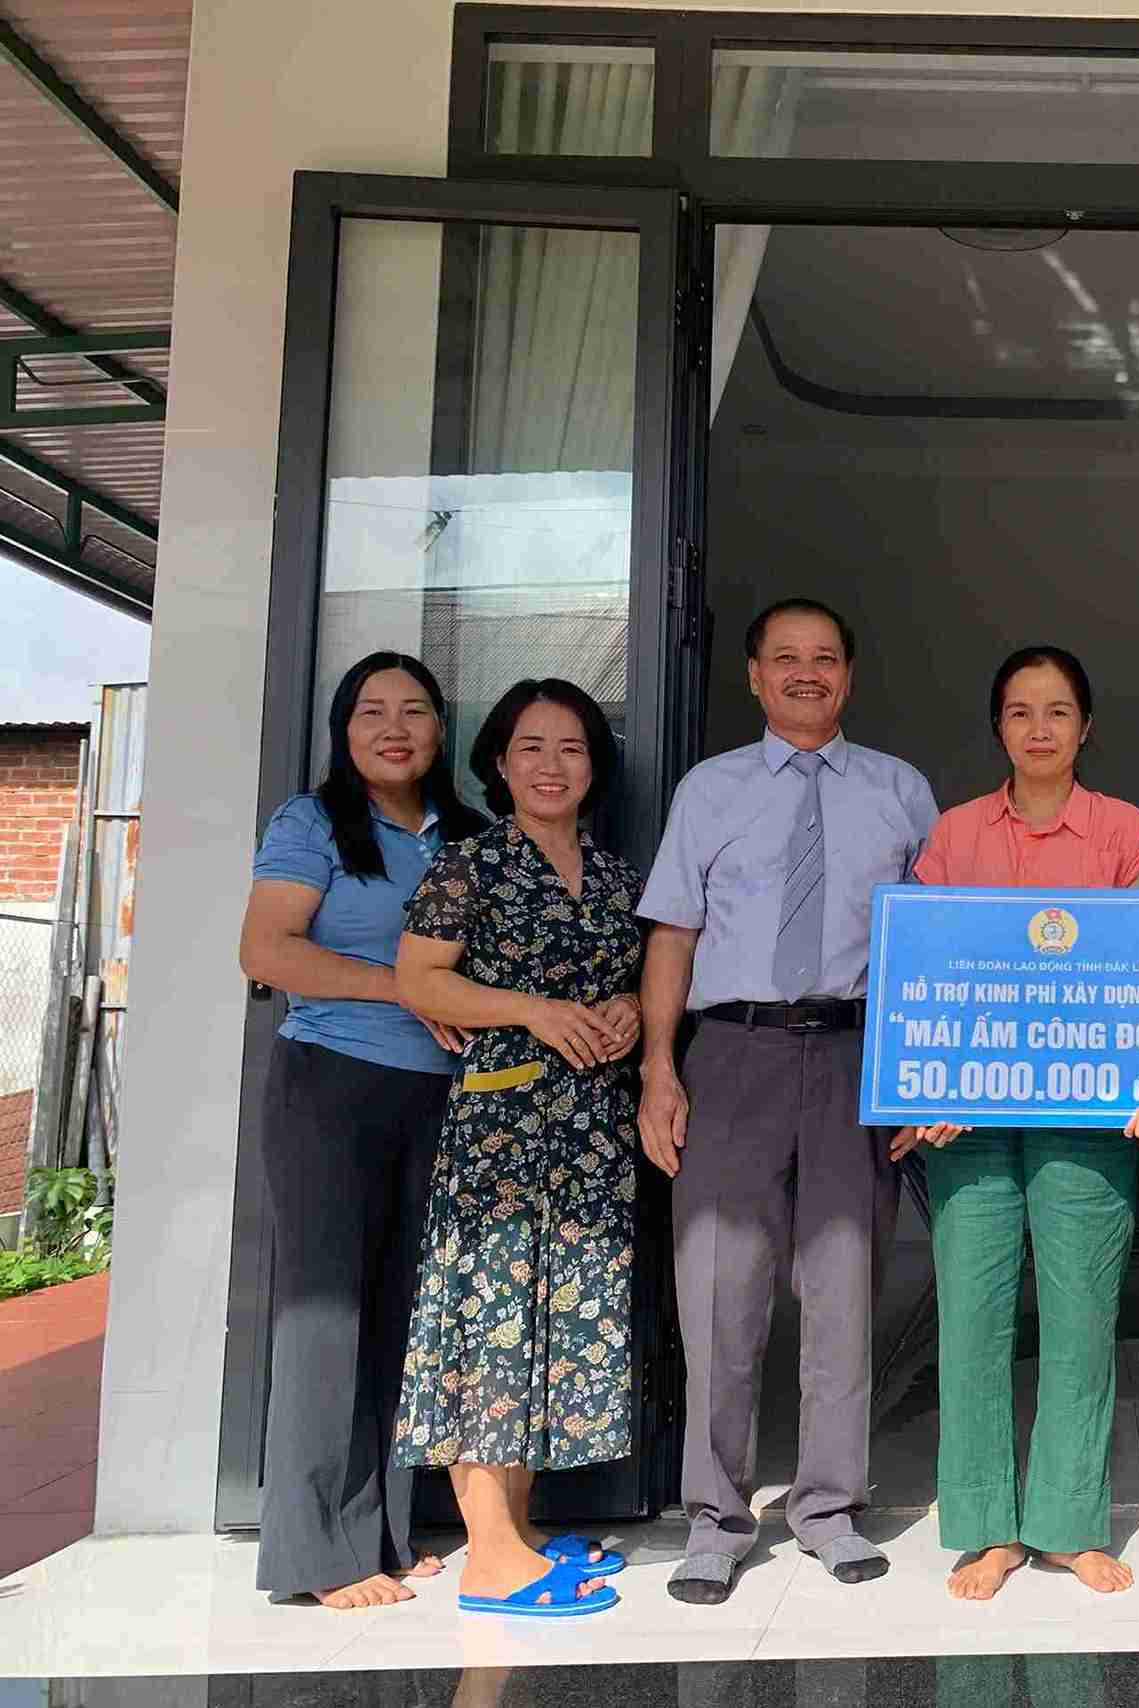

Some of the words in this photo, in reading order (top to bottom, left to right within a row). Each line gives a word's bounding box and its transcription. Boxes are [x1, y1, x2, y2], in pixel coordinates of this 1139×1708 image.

[1013, 960, 1037, 972] LAO
[902, 976, 927, 1001] HỖ
[934, 982, 969, 1007] TRỢ
[975, 983, 1019, 1003] KINH
[1025, 981, 1056, 1004] PHÍ
[1063, 981, 1098, 1005] XÂY
[970, 1011, 1018, 1048] ẤM
[1027, 1016, 1107, 1049] CÔNG
[897, 1060, 1120, 1101] 50.000.000
